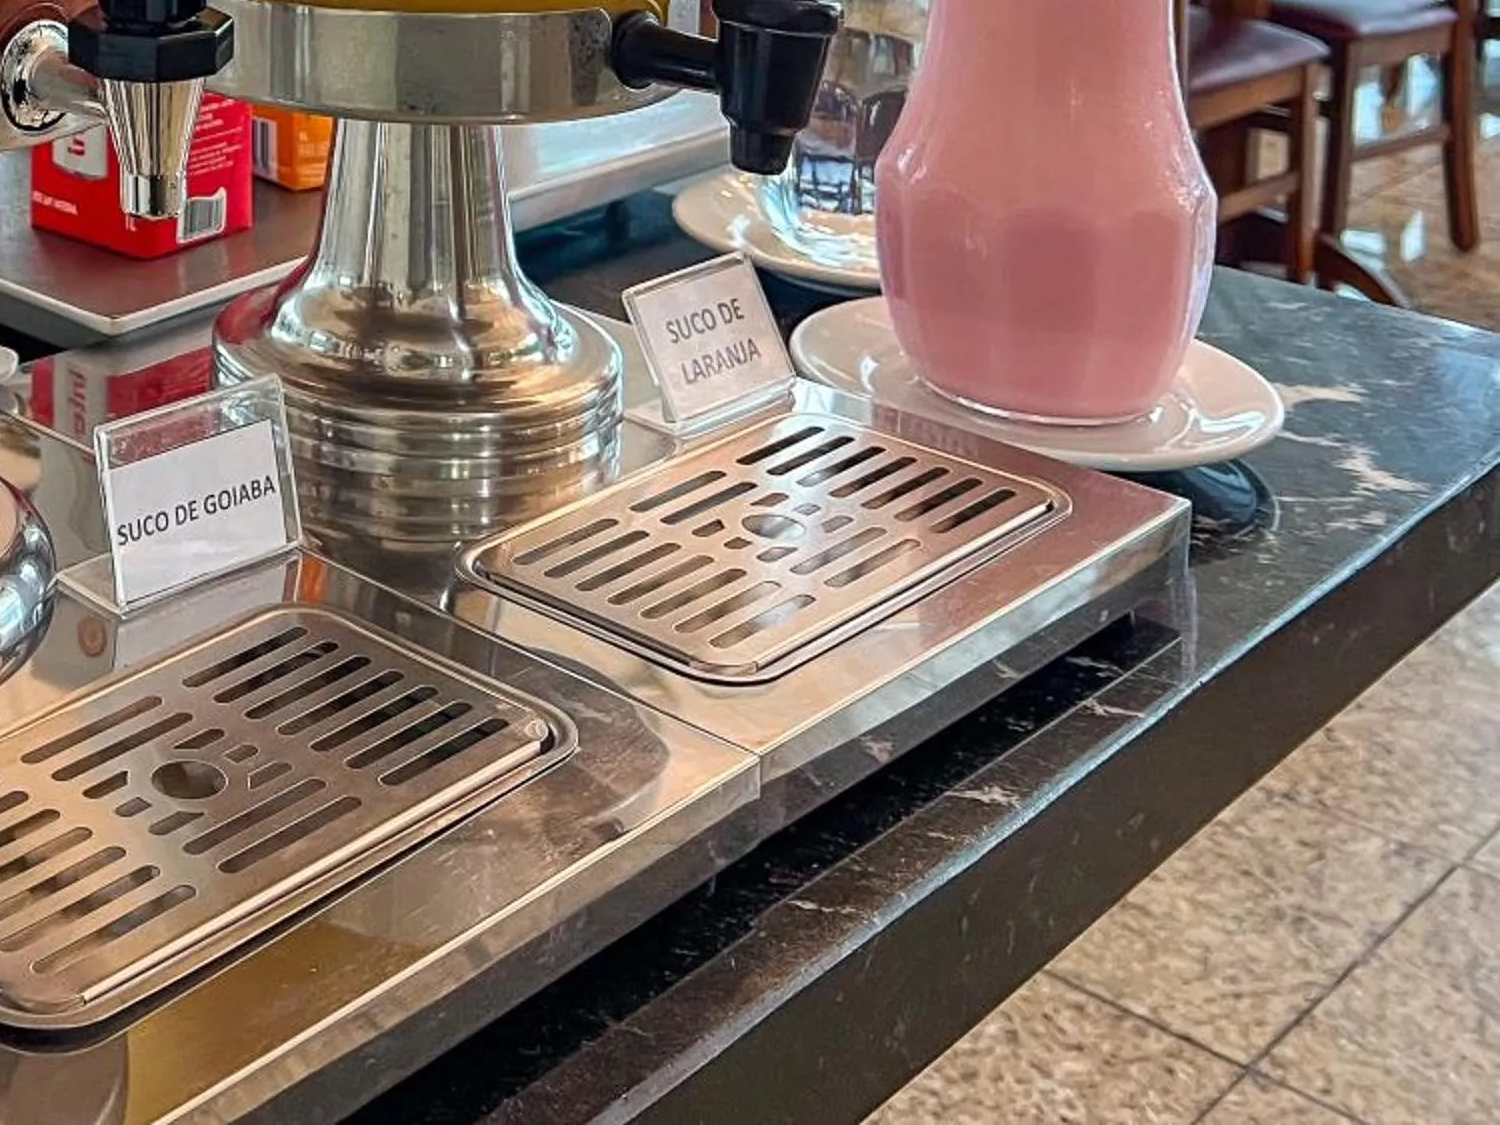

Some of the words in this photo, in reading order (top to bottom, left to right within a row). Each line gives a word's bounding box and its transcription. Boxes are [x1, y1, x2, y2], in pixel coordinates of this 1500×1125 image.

[665, 308, 717, 344] SUCO
[717, 298, 745, 324] DE
[681, 338, 762, 384] LARANJA
[117, 511, 170, 546] SUCO
[175, 500, 200, 526] DE
[203, 474, 277, 515] GOIABA
